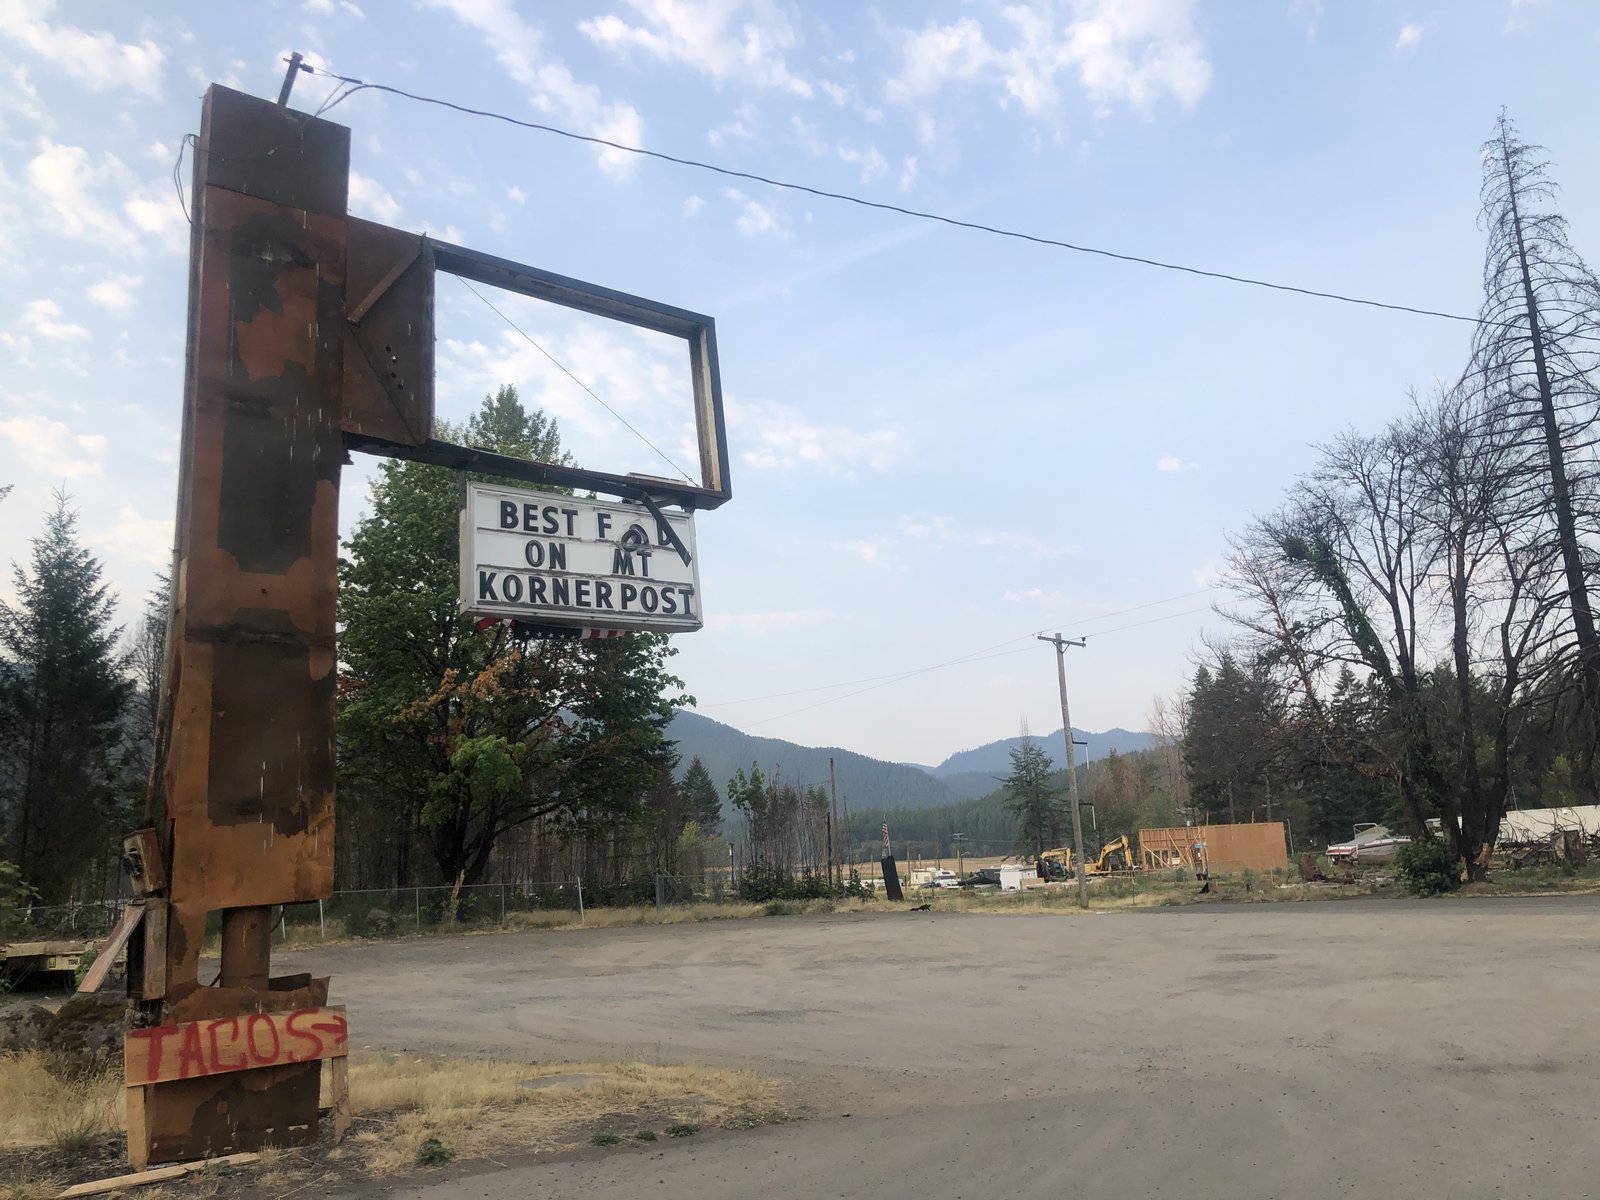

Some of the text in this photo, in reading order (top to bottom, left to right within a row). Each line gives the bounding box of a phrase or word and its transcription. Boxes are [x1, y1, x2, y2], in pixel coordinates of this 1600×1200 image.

[500, 500, 578, 536] BEST
[525, 539, 652, 577] ON MT
[479, 571, 694, 615] KORNERPOST
[132, 1008, 324, 1081] TACOS
